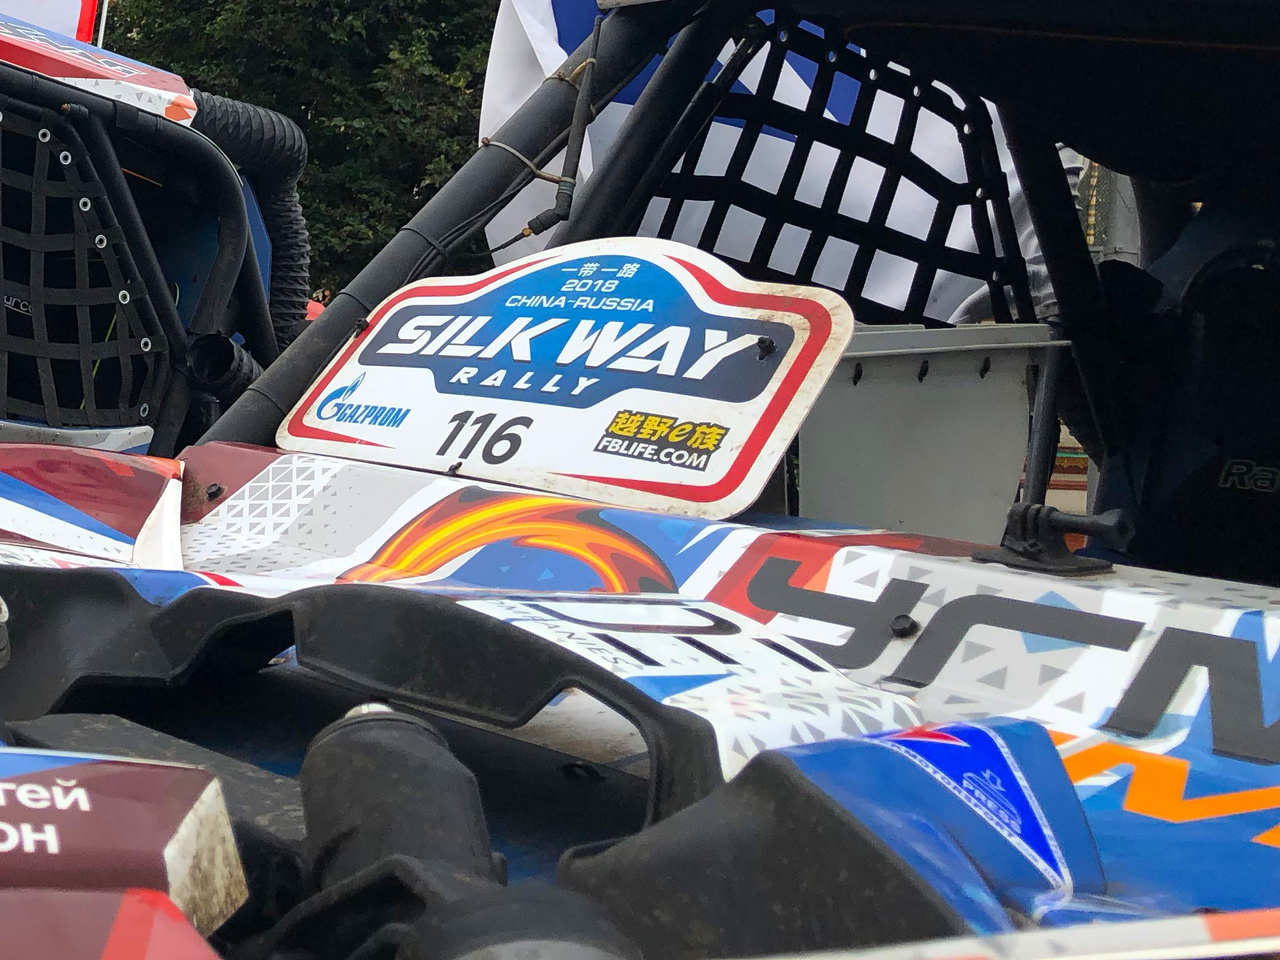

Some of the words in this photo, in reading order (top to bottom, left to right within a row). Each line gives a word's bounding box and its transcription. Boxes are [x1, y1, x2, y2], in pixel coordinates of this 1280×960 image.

[560, 278, 620, 293] 2018
[375, 314, 571, 362] SILK
[555, 318, 764, 381] WAY
[448, 366, 604, 397] RALLY
[337, 400, 412, 428] GAZPROM
[609, 410, 727, 451] 越野e族
[435, 409, 534, 465] 116
[598, 436, 709, 470] FBLIFE.COM
[962, 778, 1023, 835] PRESS
